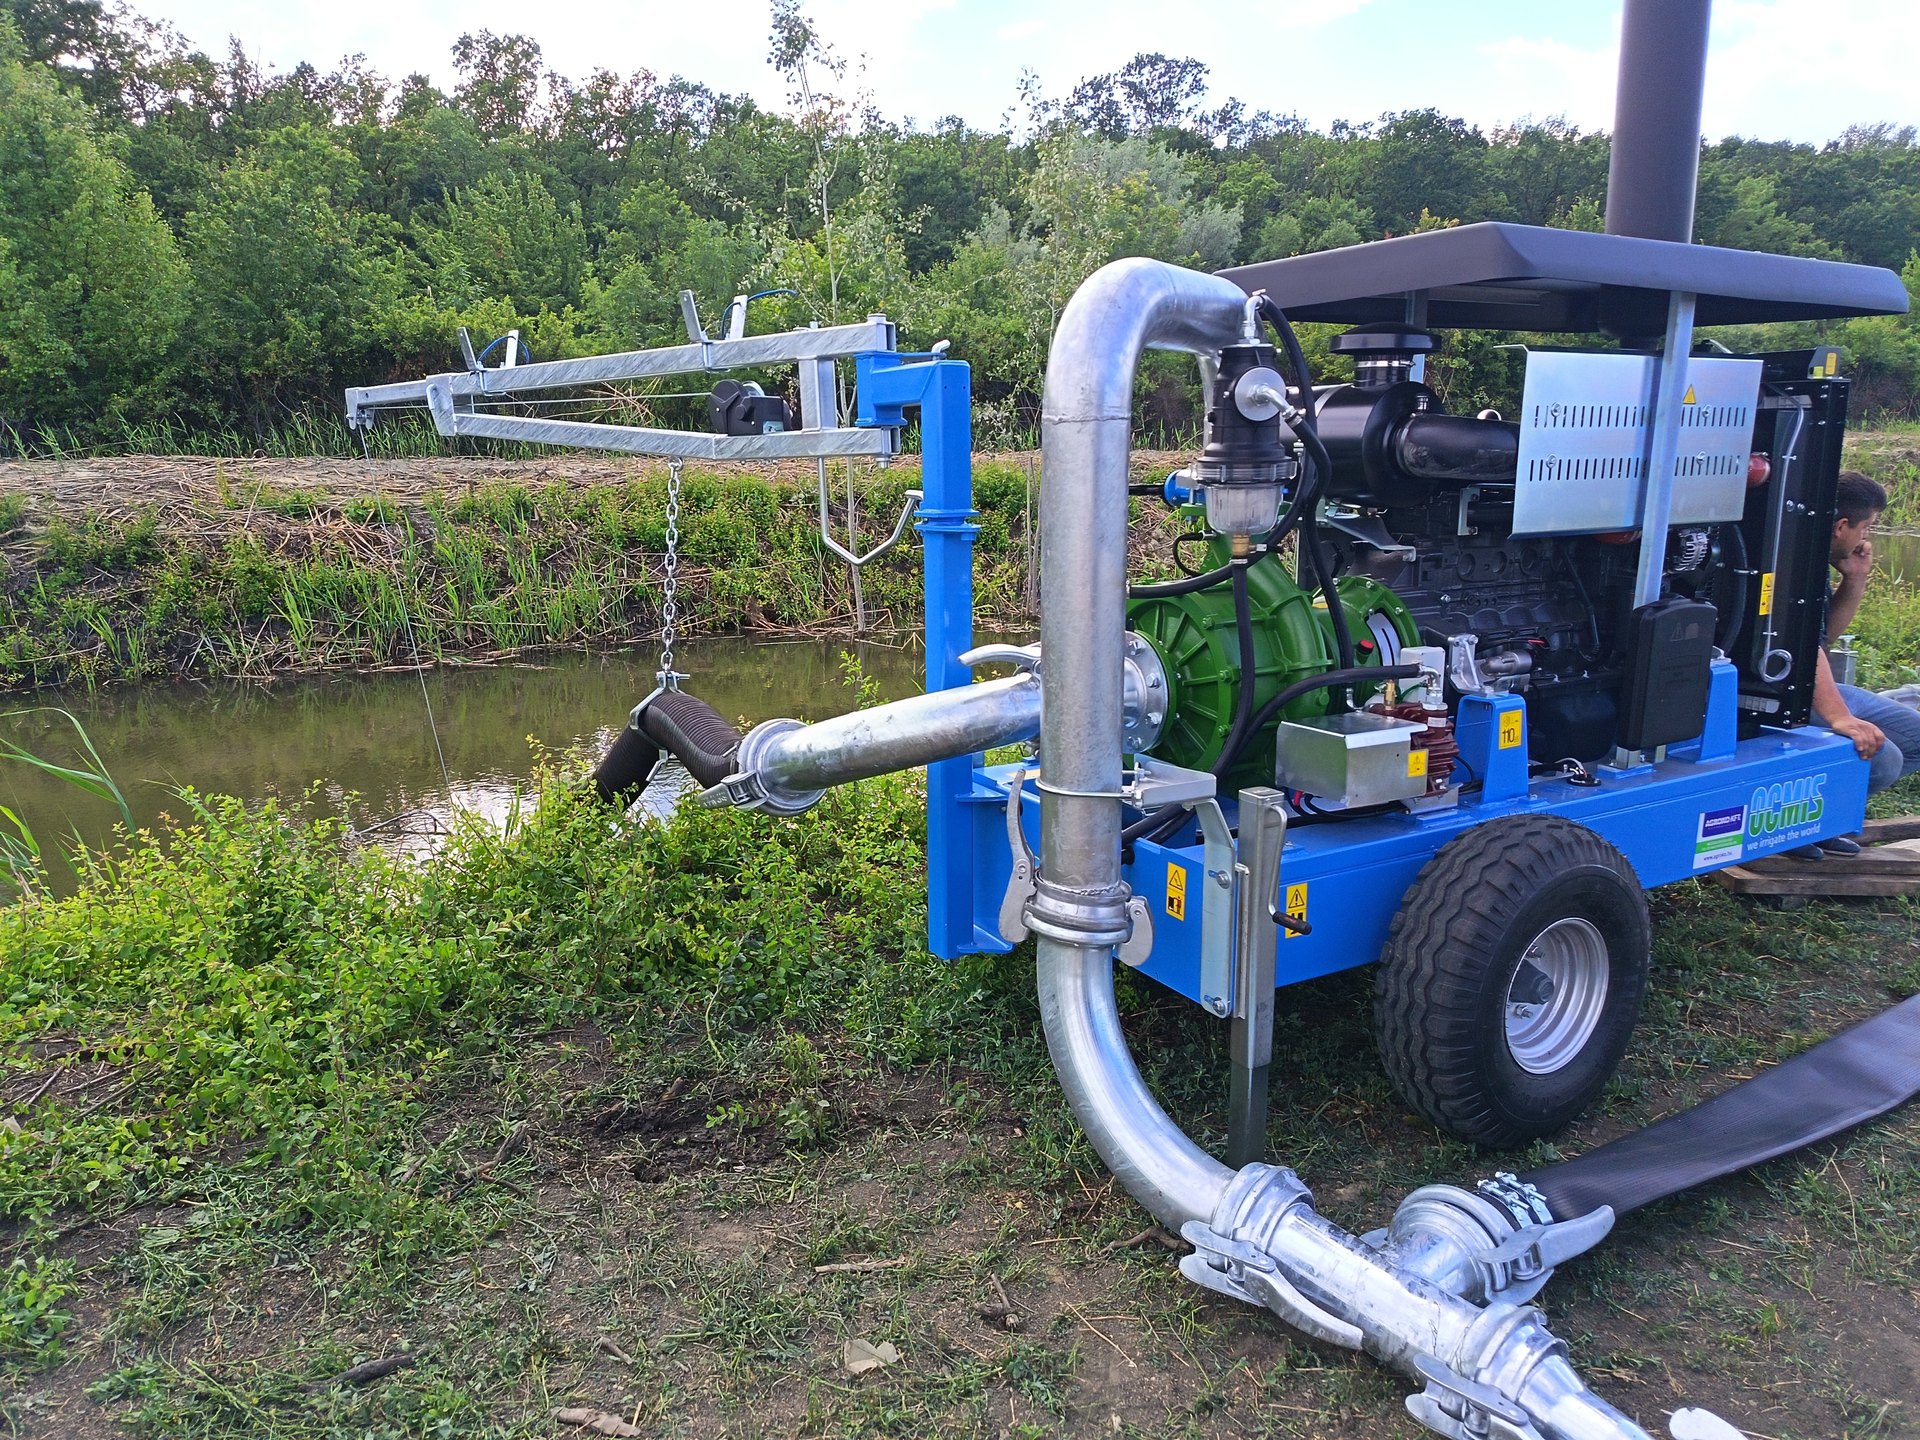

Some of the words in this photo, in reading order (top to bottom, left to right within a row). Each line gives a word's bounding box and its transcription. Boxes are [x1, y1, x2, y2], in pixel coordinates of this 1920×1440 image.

[1502, 728, 1515, 743] 110
[1748, 773, 1827, 837] OCMIS
[1747, 842, 1759, 851] we
[1759, 835, 1786, 848] irrigate
[1786, 829, 1800, 841] the
[1800, 823, 1821, 837] world
